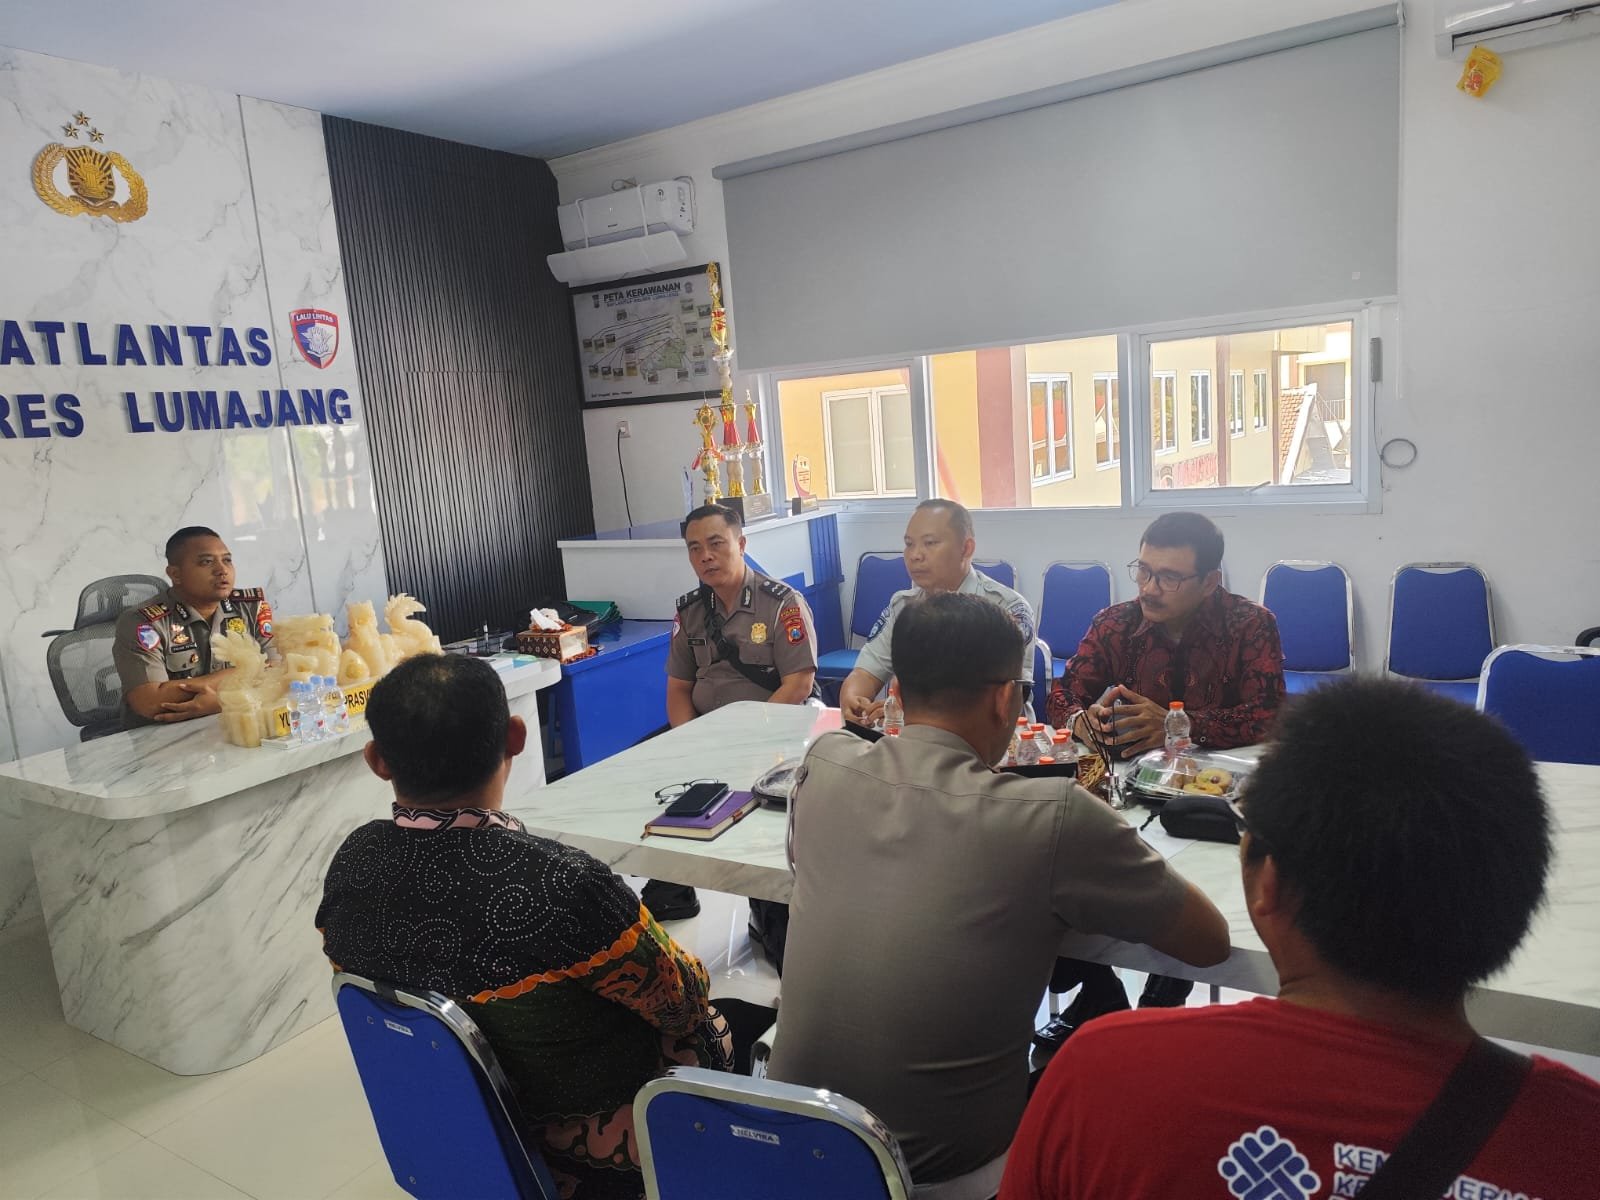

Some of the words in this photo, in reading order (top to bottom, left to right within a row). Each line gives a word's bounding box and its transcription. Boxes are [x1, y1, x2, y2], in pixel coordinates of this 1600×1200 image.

[603, 291, 624, 302] PETA
[626, 282, 681, 297] KERAWANAN
[0, 319, 272, 367] ATLANTAS
[125, 388, 353, 434] LUMAJANG
